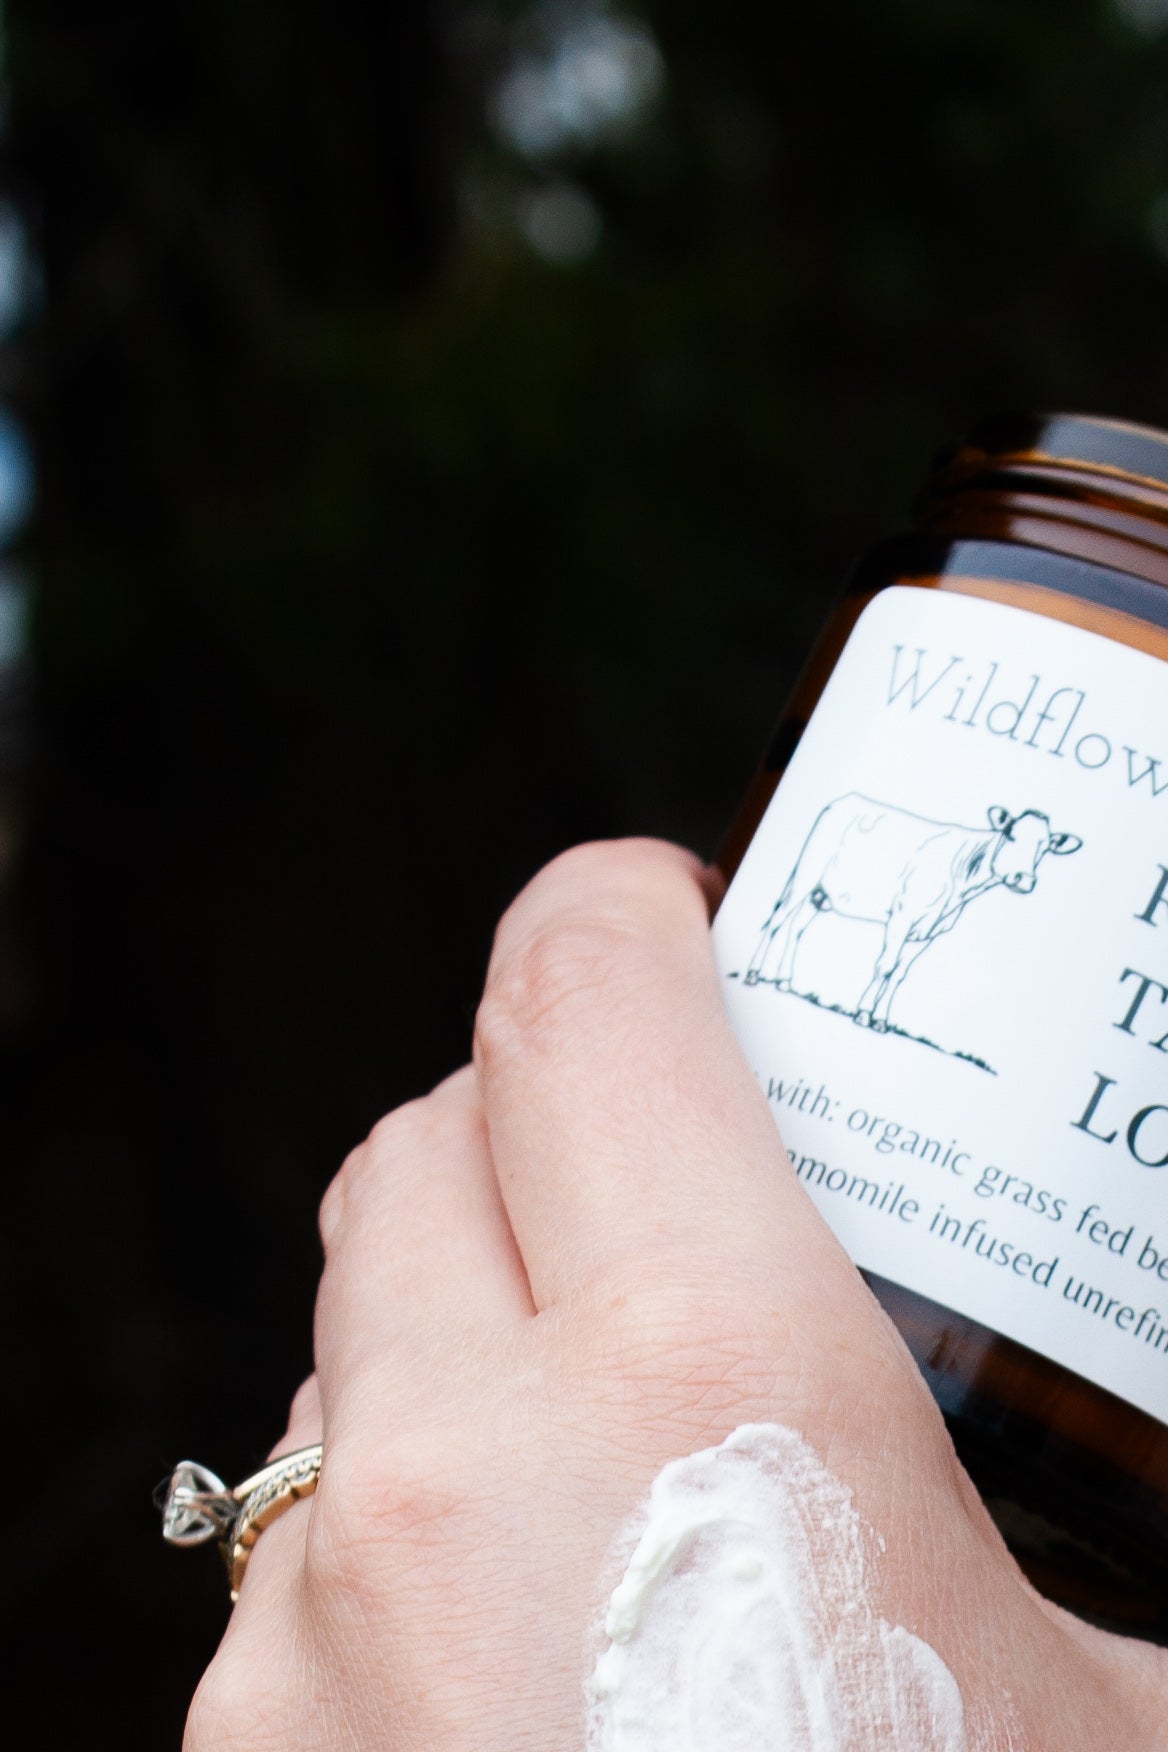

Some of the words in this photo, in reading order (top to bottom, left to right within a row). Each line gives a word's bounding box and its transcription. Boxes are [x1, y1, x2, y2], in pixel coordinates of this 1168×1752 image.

[767, 1076, 840, 1122] with:
[847, 1108, 971, 1176] organic
[974, 1165, 1068, 1222] grass
[1075, 1204, 1134, 1256] fed
[929, 1204, 1059, 1288] infused
